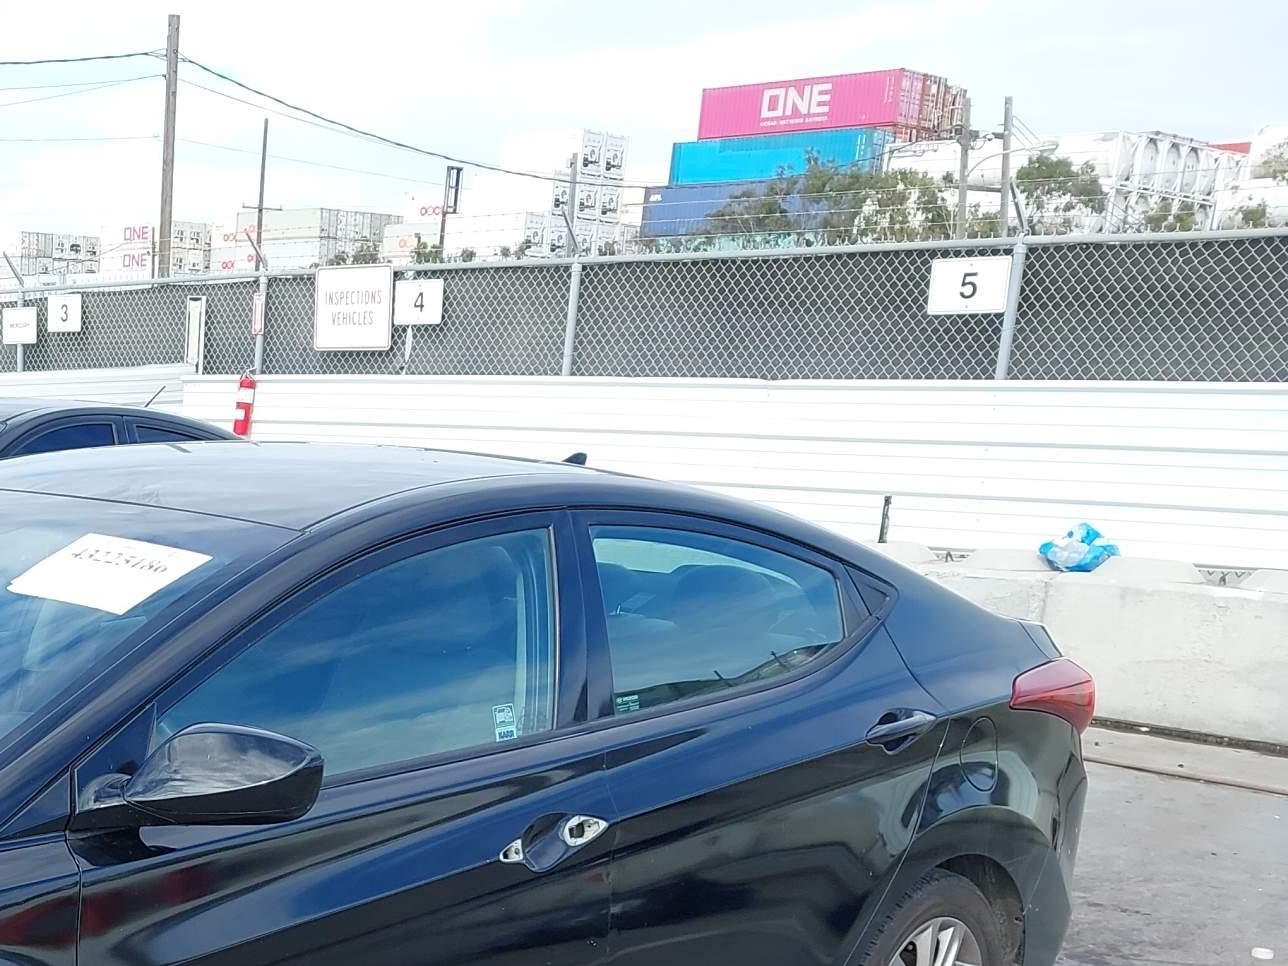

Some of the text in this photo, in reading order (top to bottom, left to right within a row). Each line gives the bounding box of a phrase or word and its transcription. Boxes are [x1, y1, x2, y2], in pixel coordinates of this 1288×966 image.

[760, 83, 833, 118] ONE
[124, 226, 149, 241] ONE
[123, 253, 148, 268] ONE
[960, 272, 978, 299] 5
[325, 289, 382, 306] INSPECTIONS
[414, 292, 425, 313] 4
[61, 304, 68, 322] 3
[332, 311, 374, 326] VEHICLES
